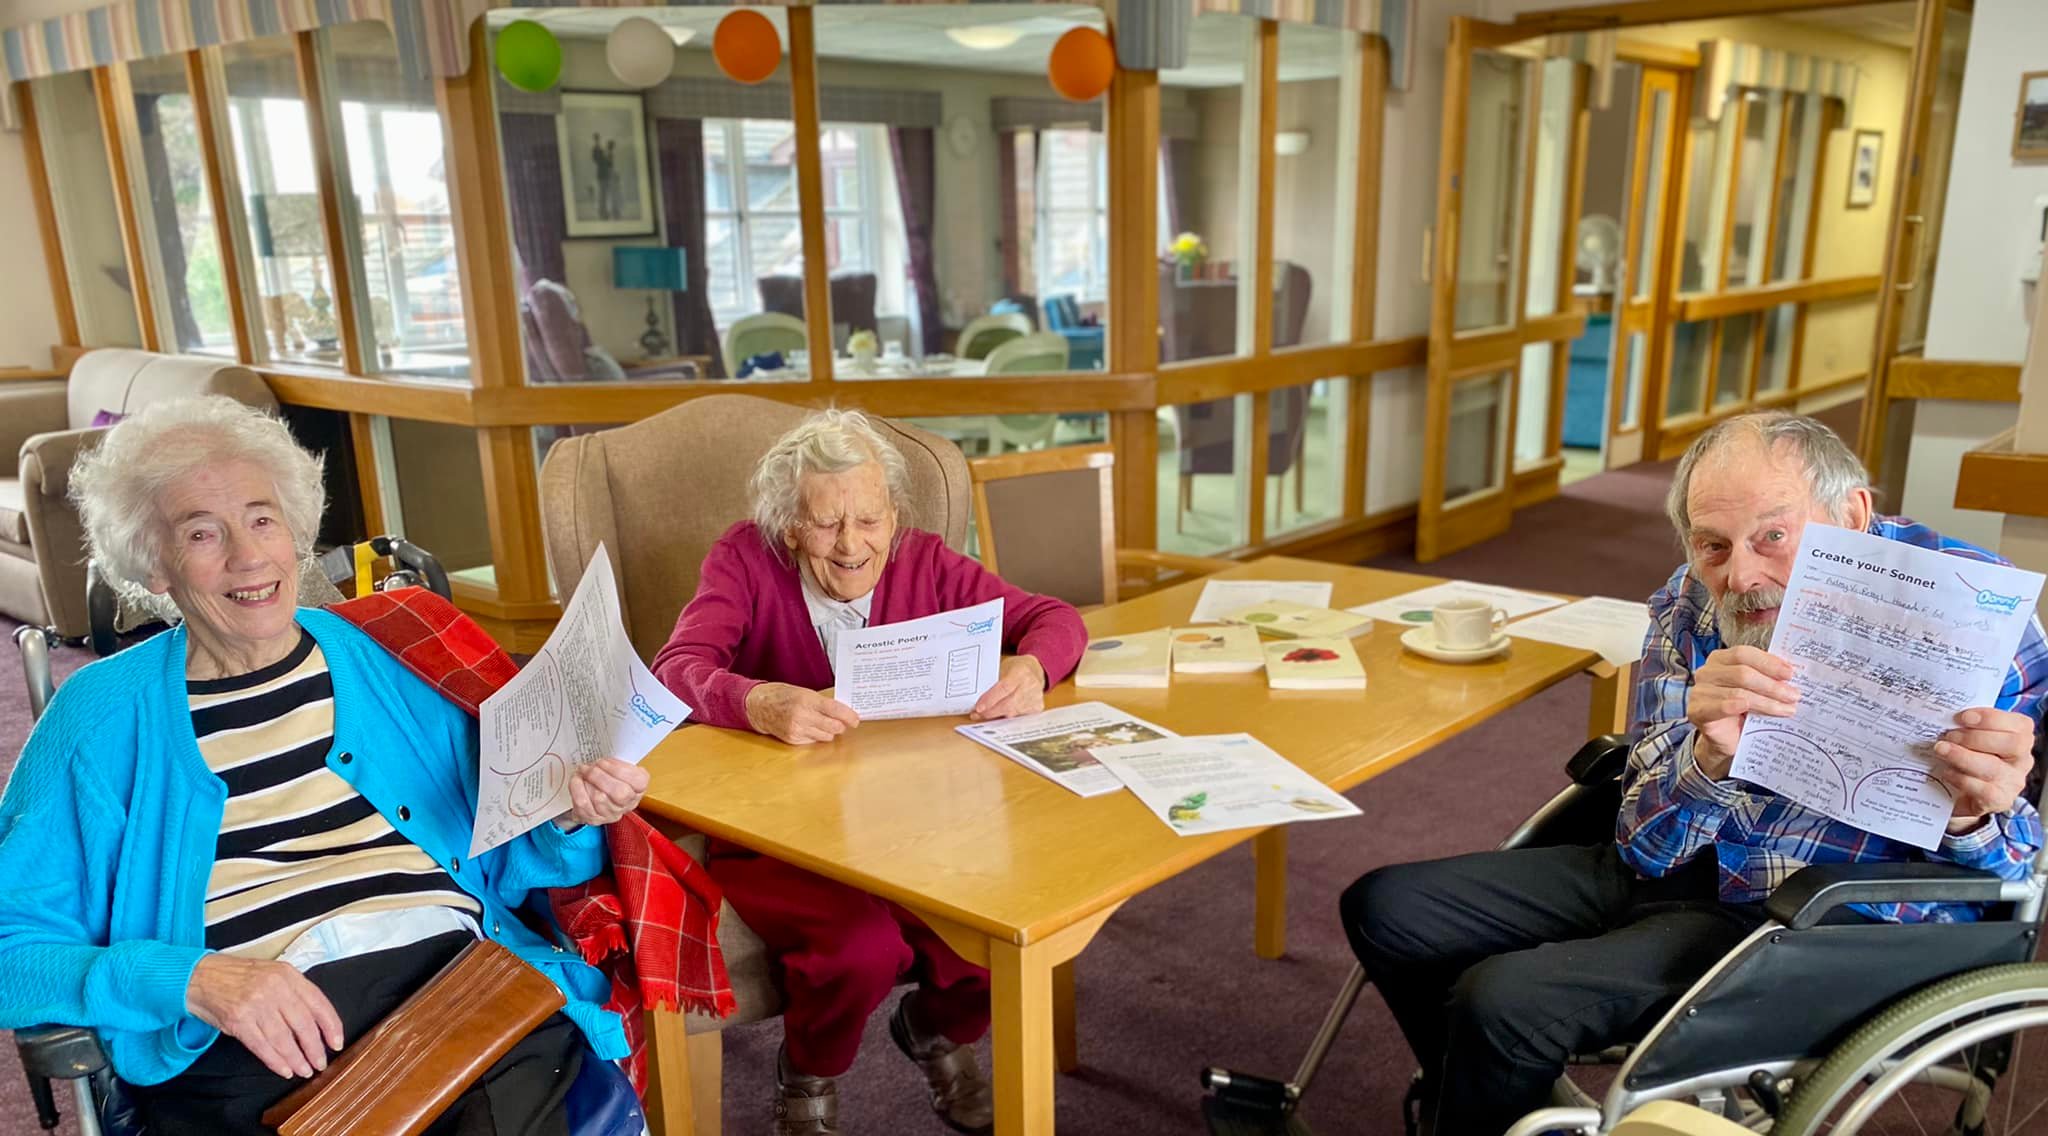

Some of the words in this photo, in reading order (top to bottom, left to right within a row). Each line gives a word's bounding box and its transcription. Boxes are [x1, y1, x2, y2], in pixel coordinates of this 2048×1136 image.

[1811, 548, 1853, 567] Create
[1857, 559, 1887, 576] your
[1890, 568, 1937, 590] Sonnet
[856, 639, 895, 649] Acrostic
[898, 634, 929, 644] Poetry
